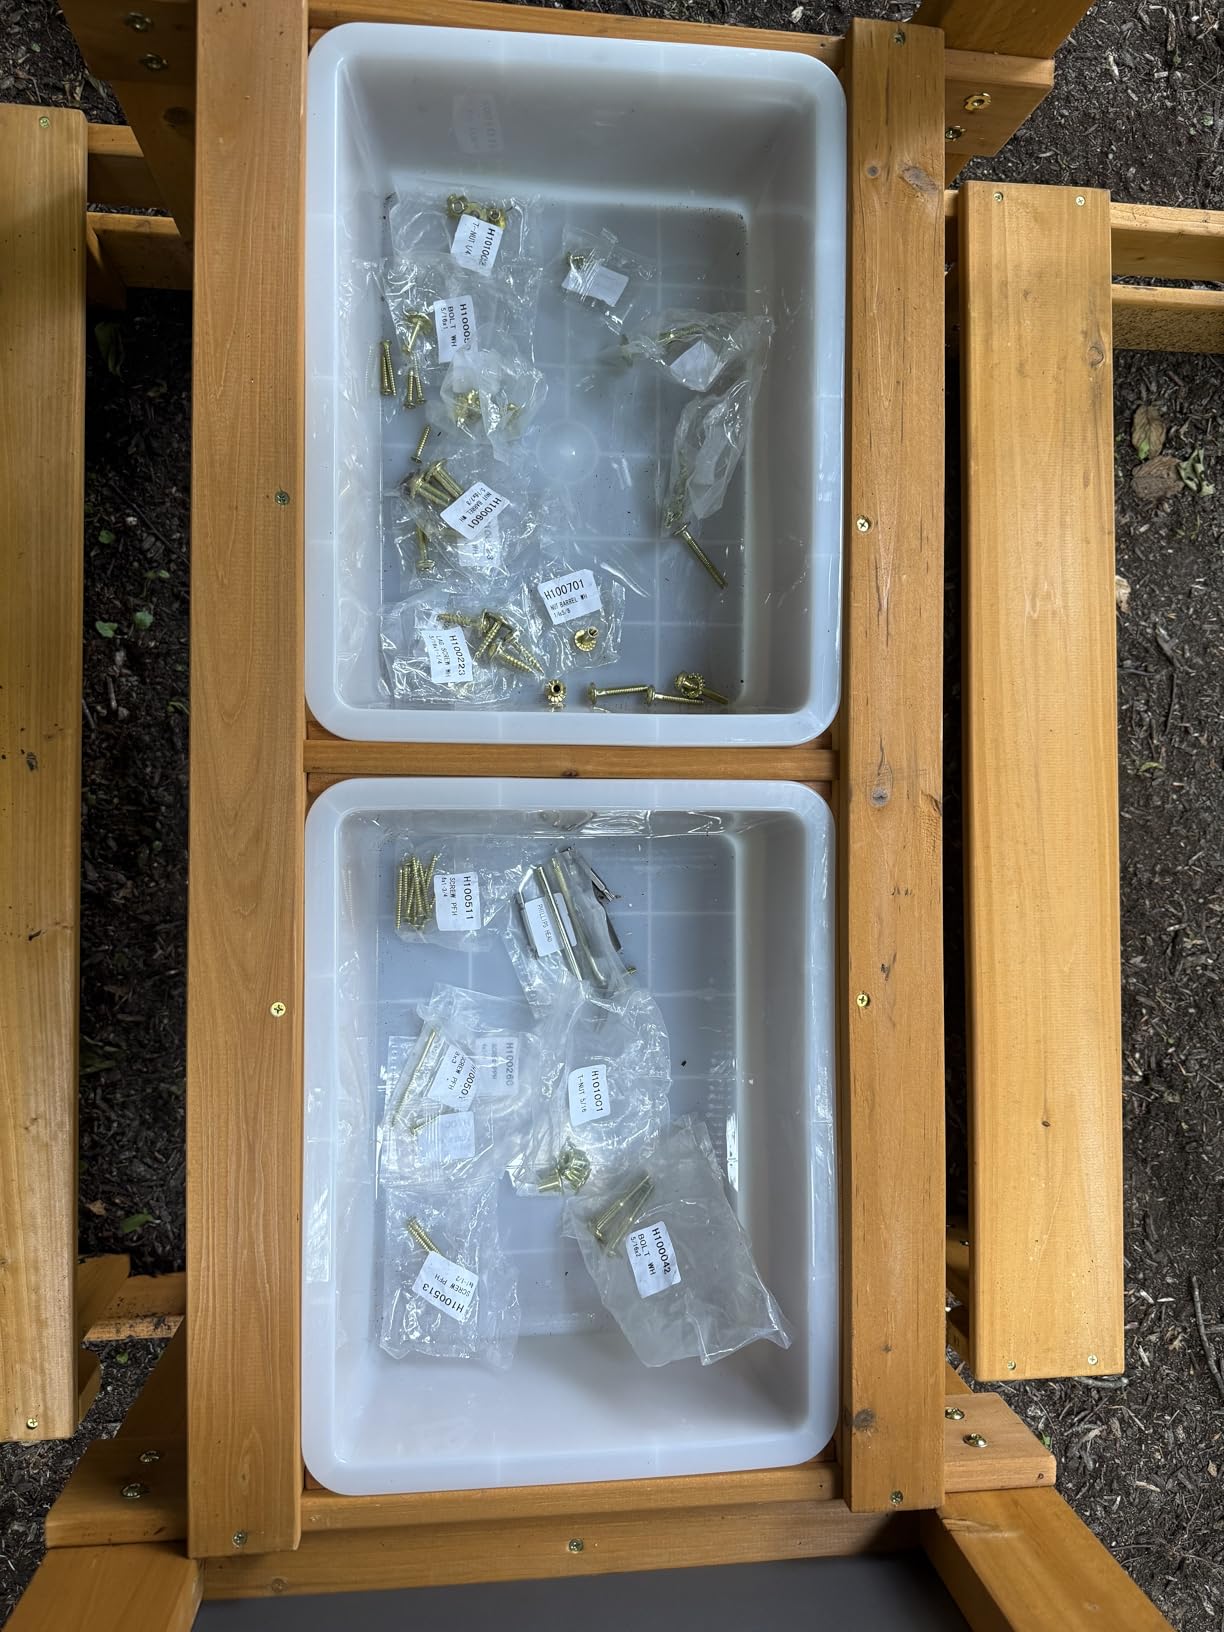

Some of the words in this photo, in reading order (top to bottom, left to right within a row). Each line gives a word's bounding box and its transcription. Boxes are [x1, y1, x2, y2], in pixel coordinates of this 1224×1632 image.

[448, 306, 457, 329] BOLT
[460, 303, 472, 350] H1000
[451, 334, 457, 347] WH
[468, 497, 502, 529] H100601
[543, 578, 585, 600] H100701
[559, 597, 578, 607] BARREL
[436, 635, 445, 645] LAG
[440, 648, 450, 665] SCREW
[449, 635, 466, 676] H100223
[463, 876, 474, 919] H100511
[537, 903, 548, 928] PHILLIPS
[544, 930, 553, 943] HEAD
[448, 1076, 457, 1090] PFH
[577, 1074, 585, 1094] T-NUT
[591, 1070, 604, 1112] H101001
[630, 1236, 642, 1257] 5/16x2
[638, 1233, 650, 1256] BOLT
[647, 1262, 656, 1275] WH
[652, 1227, 671, 1274] H100042
[435, 1273, 447, 1285] PFH
[450, 1283, 471, 1297] SCREW
[422, 1283, 464, 1313] H100513
